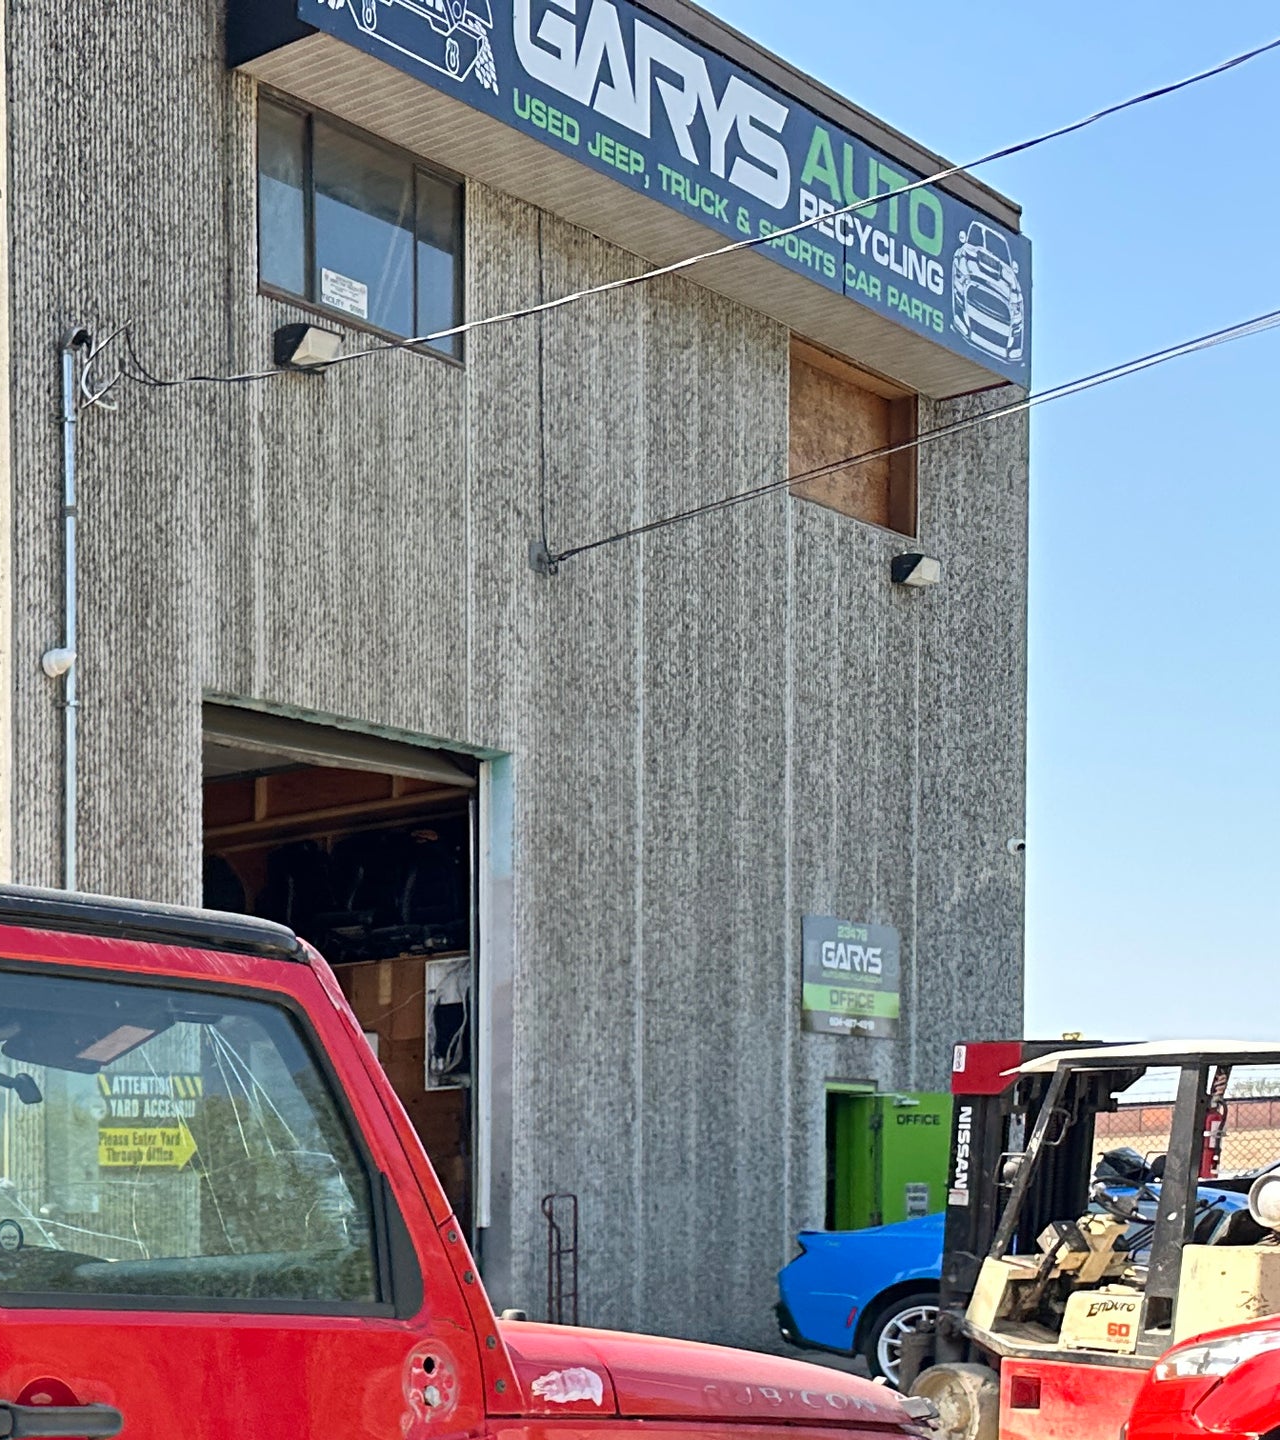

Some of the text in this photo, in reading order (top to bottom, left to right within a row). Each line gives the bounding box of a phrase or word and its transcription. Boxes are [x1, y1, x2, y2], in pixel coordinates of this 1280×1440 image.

[513, 0, 791, 209] GARYS
[513, 87, 944, 333] USED JEEP, TRUCK & SPORTS CAR PARTS
[800, 125, 944, 257] AUTO
[799, 188, 944, 296] RECYCLING
[822, 941, 883, 975] GARYS
[830, 989, 875, 1010] OFFICE
[110, 1099, 139, 1118] YARD
[896, 1113, 941, 1126] OFFICE
[160, 1131, 181, 1146] Yard
[954, 1106, 973, 1189] NISSAN
